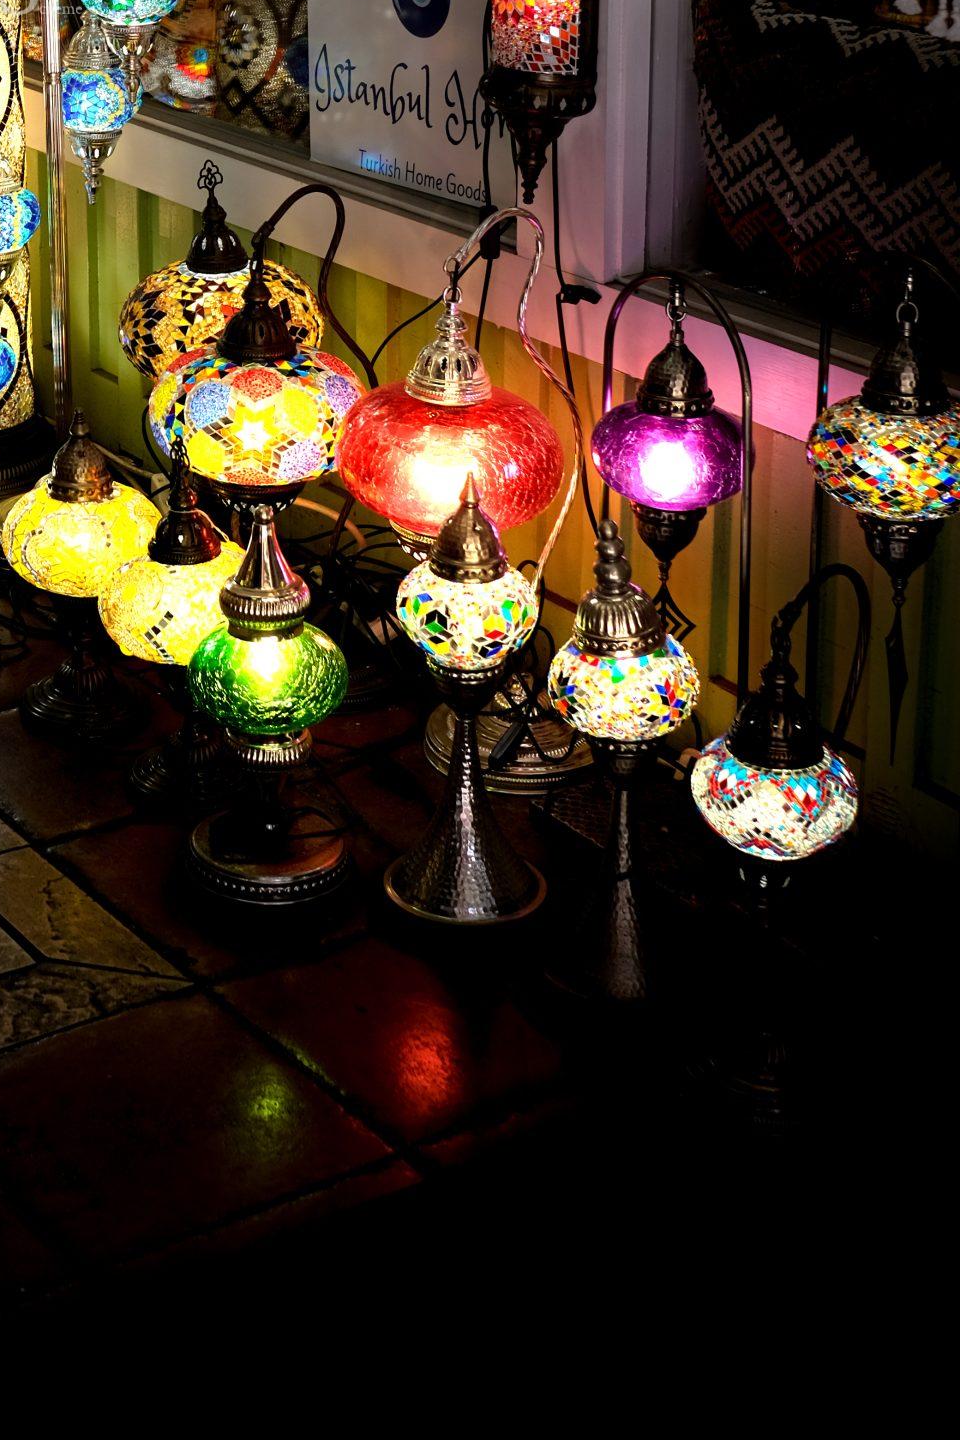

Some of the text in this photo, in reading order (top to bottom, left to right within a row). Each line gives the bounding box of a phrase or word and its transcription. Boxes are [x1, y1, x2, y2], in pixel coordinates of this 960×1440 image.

[314, 43, 433, 129] Istanbul
[359, 148, 488, 204] Turkish Home Goods
